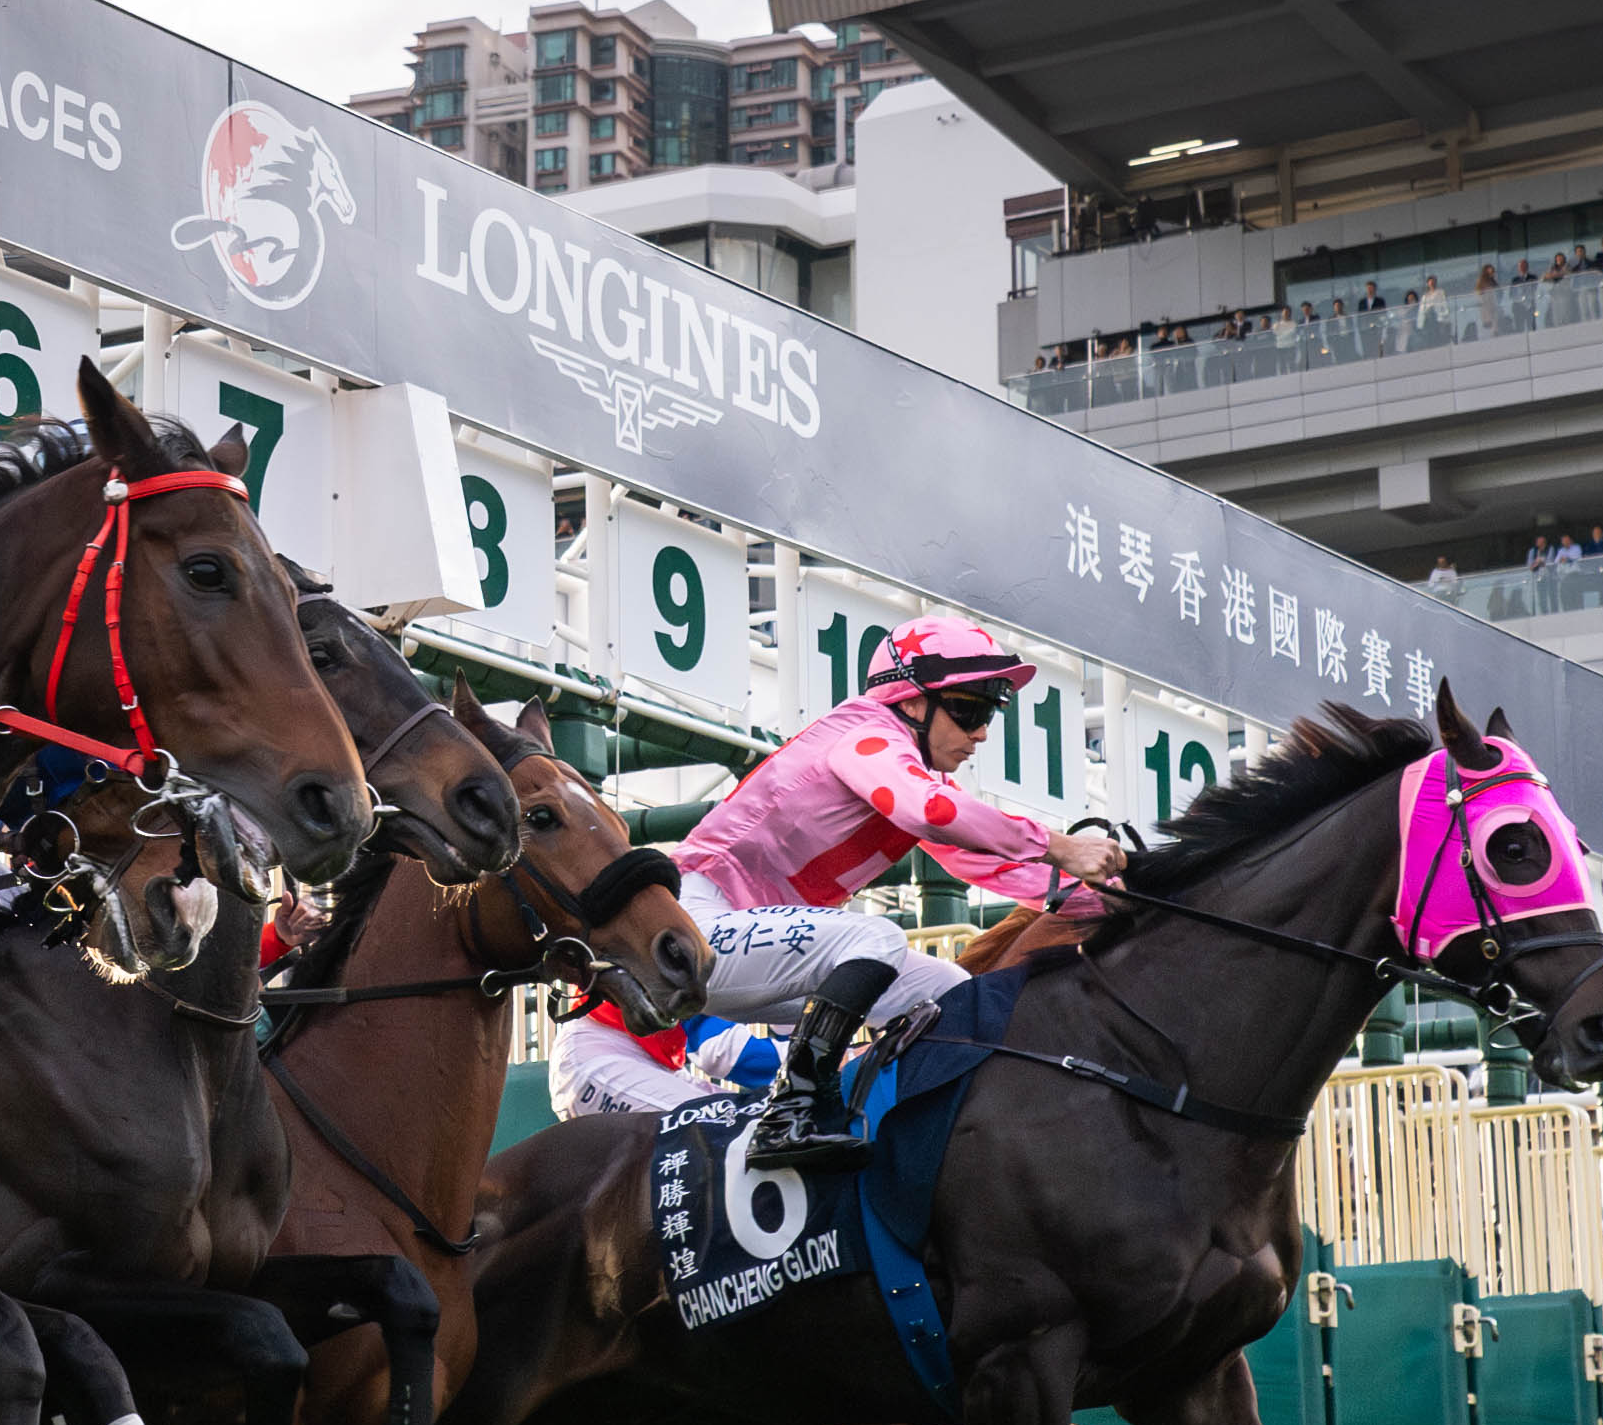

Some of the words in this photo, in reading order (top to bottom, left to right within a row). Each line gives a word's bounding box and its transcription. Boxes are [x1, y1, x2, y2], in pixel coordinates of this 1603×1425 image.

[415, 177, 821, 438] LONGINES
[219, 381, 284, 525] 7
[461, 475, 509, 608] 8
[652, 546, 706, 672] 9
[1065, 503, 1437, 719] 浪琴香港國際賽事
[994, 686, 1064, 800] 11
[581, 1083, 595, 1103] D
[725, 1118, 808, 1259] 6
[678, 1261, 784, 1330] CHANCHENG
[783, 1230, 840, 1282] GLORY
